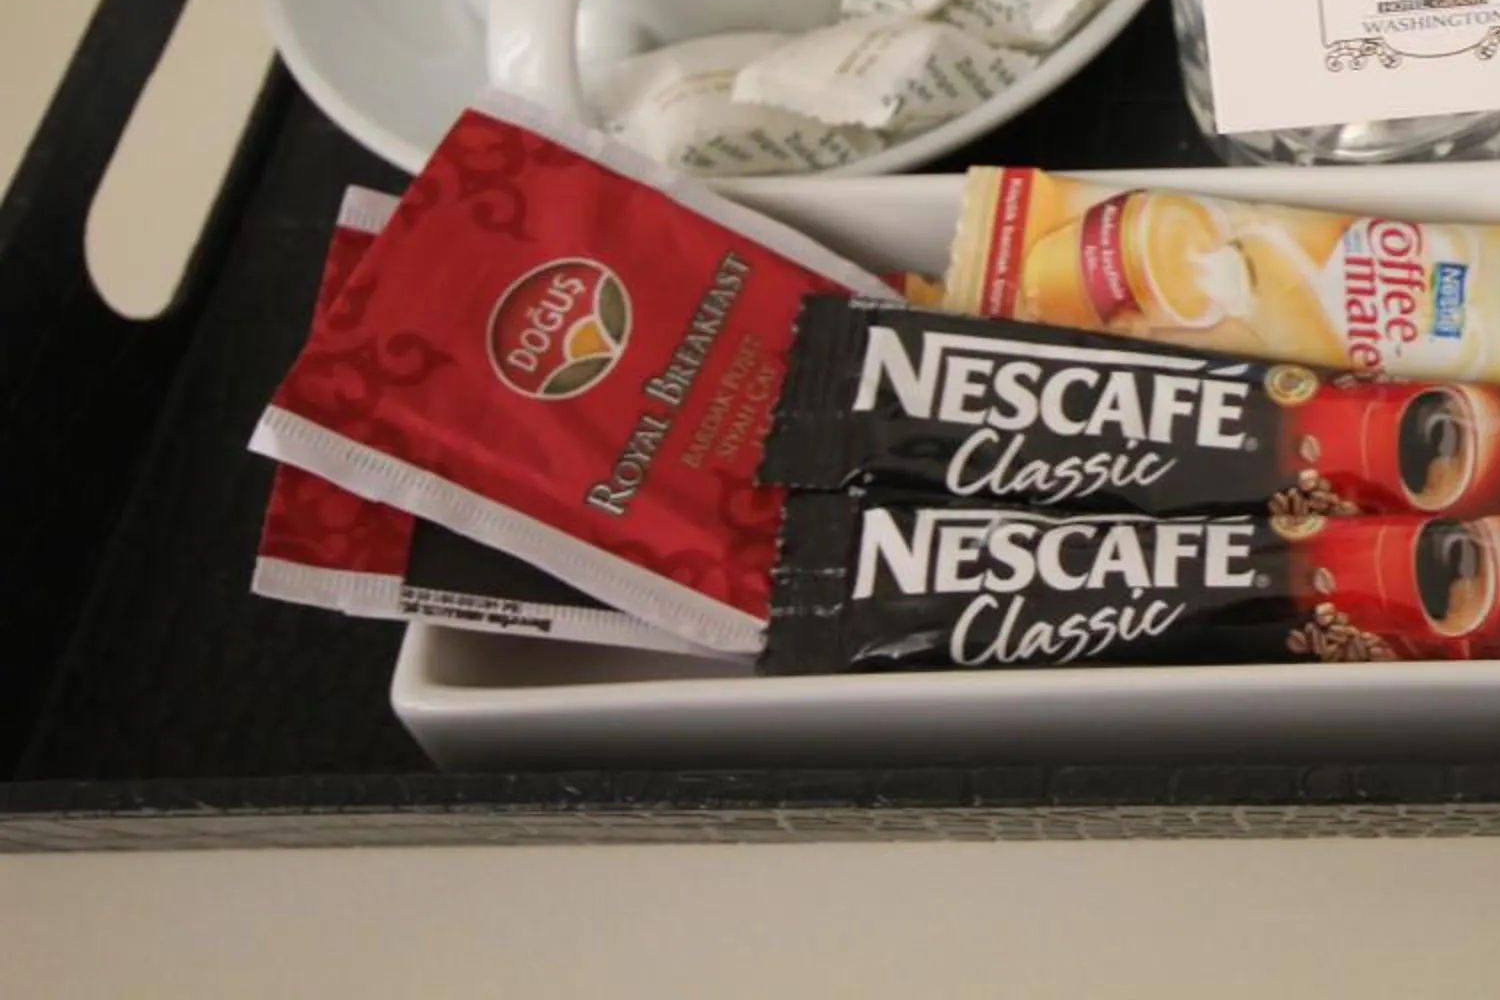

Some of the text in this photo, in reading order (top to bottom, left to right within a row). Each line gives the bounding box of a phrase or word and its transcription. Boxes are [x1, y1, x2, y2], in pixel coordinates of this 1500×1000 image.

[507, 272, 585, 373] DOĞUŞ
[853, 326, 1250, 450] NESCAFÉ
[946, 427, 1177, 504] Classic
[853, 508, 1255, 599] NESCAFÉ
[950, 586, 1186, 665] Classic
